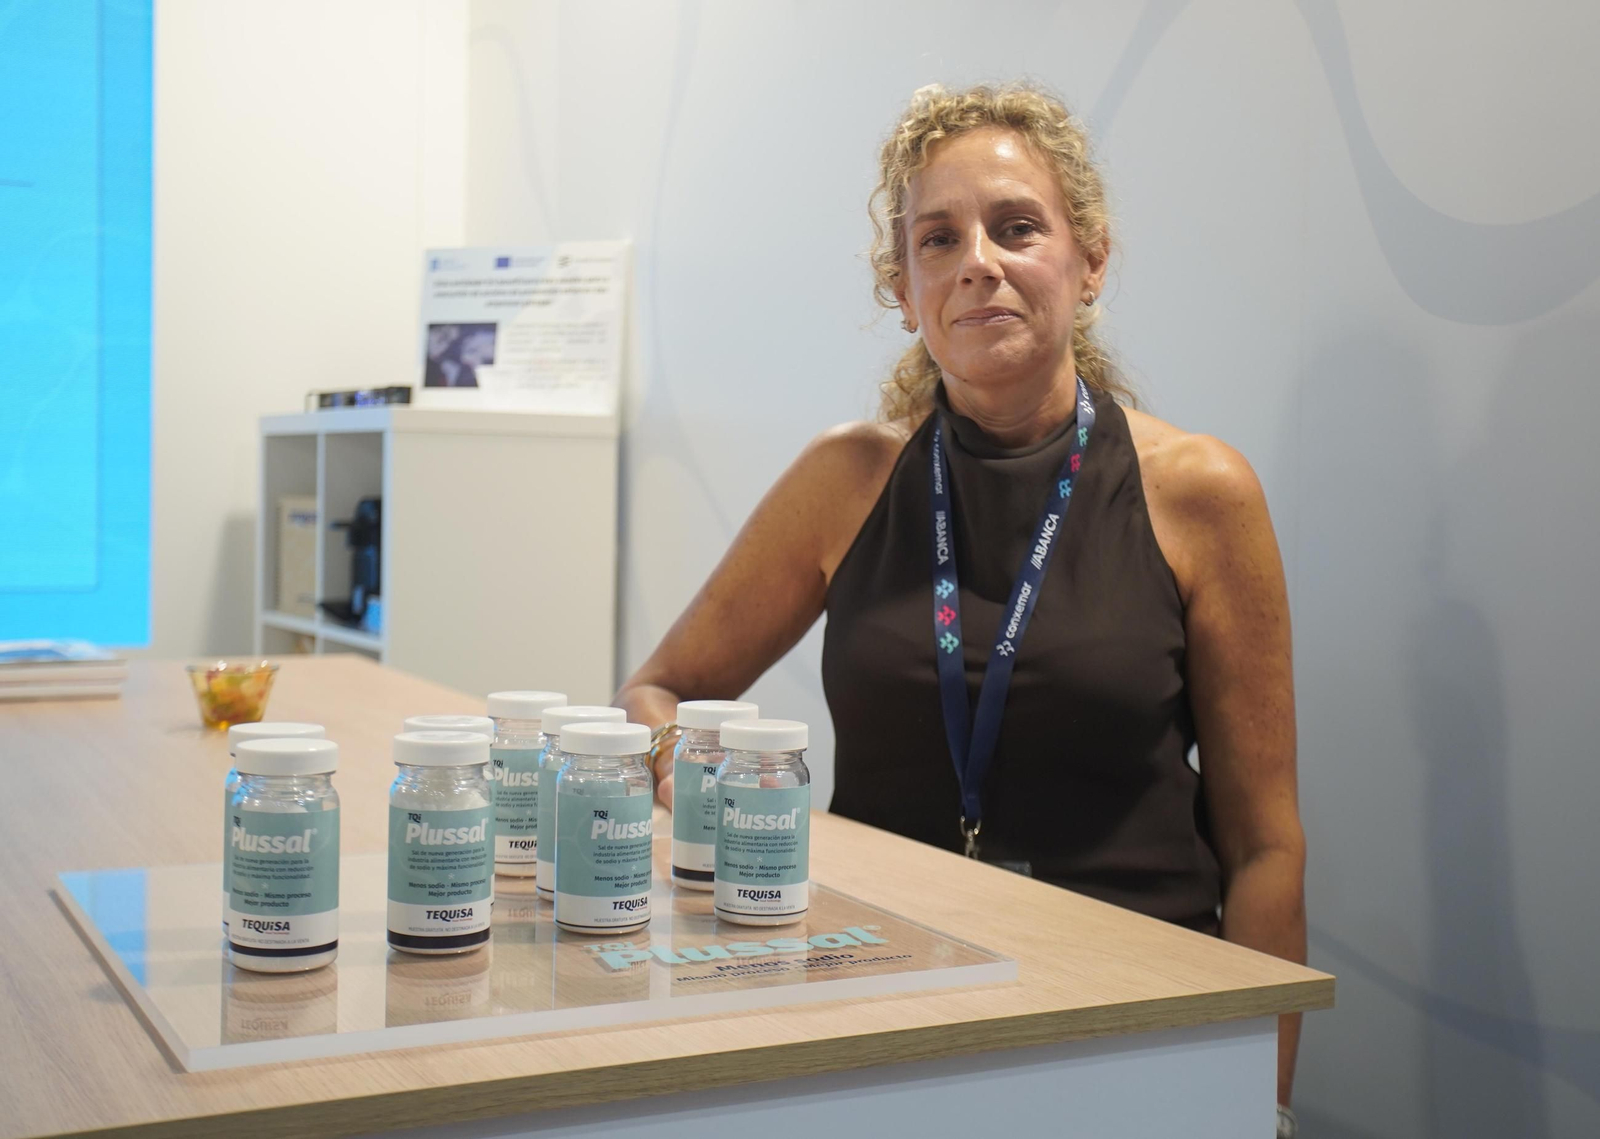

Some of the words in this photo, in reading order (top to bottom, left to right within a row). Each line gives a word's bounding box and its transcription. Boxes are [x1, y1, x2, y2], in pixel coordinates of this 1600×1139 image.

[1005, 580, 1033, 639] conxemar
[724, 797, 735, 808] TQi
[408, 812, 422, 823] TQi
[593, 810, 609, 819] TQi
[445, 849, 472, 857] generación
[755, 871, 781, 879] producto
[446, 889, 472, 897] producto
[243, 898, 259, 906] Mejor
[260, 900, 290, 908] producto
[715, 959, 790, 972] Menos
[793, 953, 854, 965] sodio
[676, 972, 727, 982] Mismo
[731, 967, 790, 978] proceso
[803, 959, 845, 969] Mejor
[847, 954, 913, 965] producto
